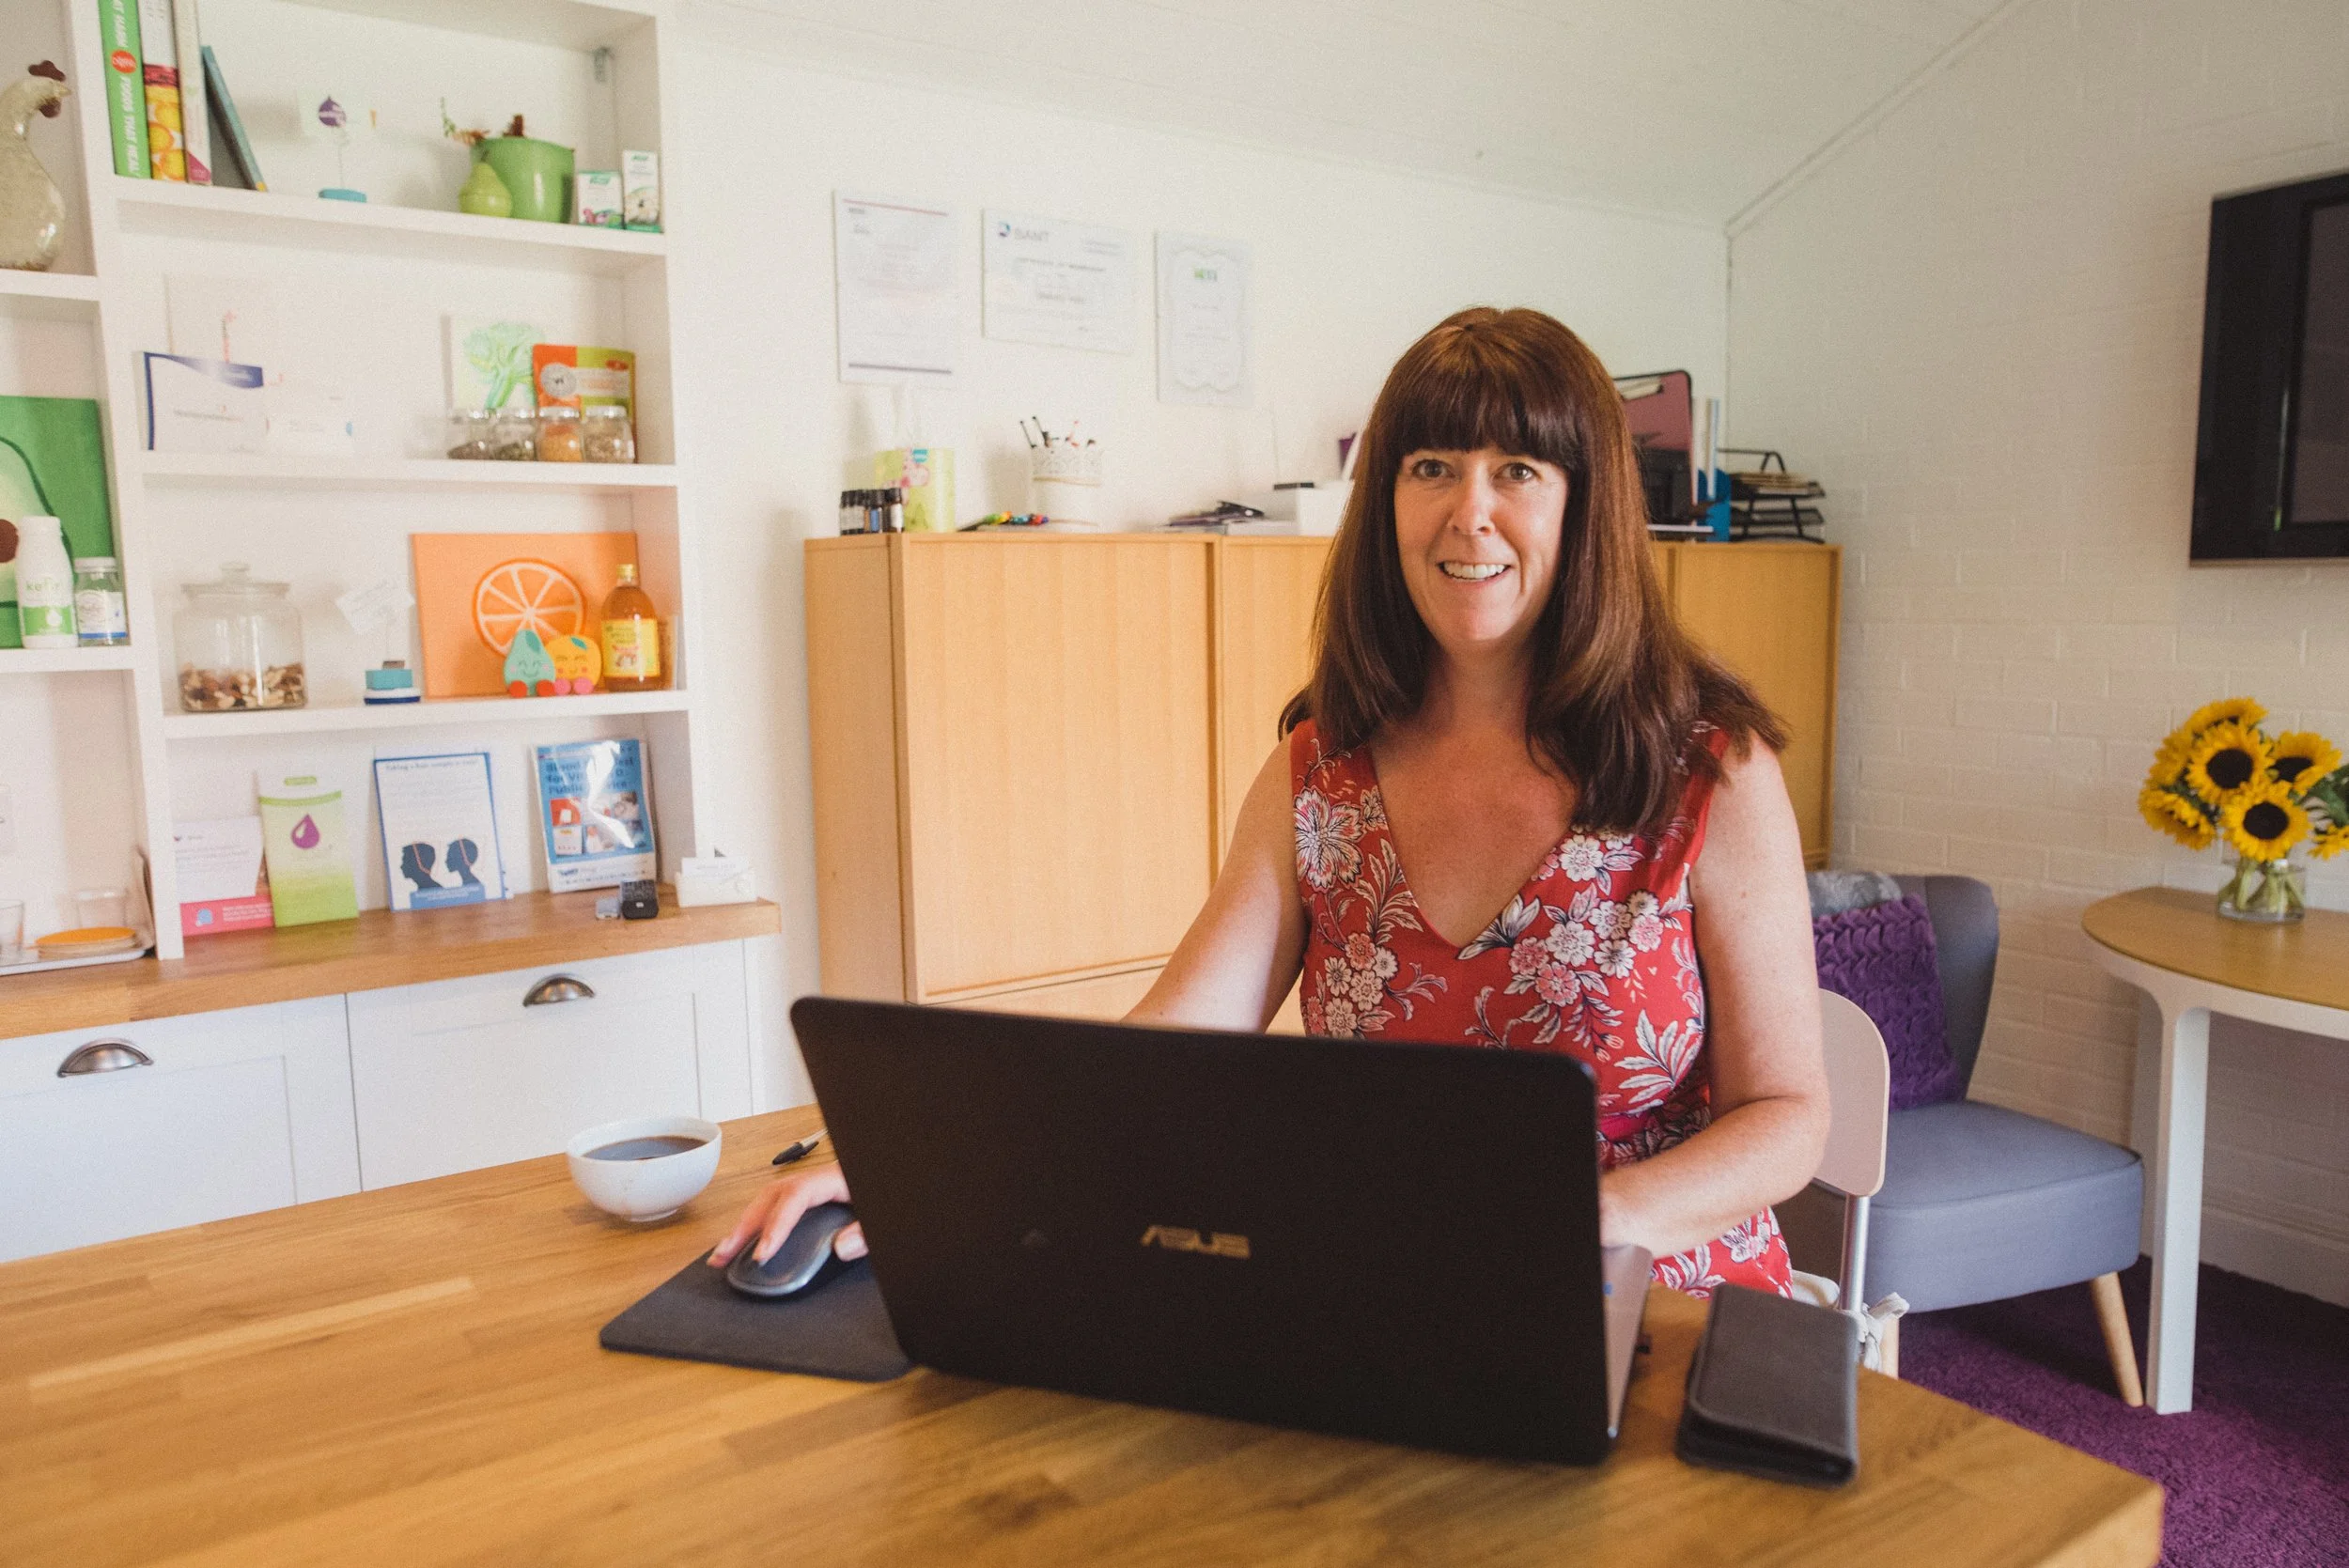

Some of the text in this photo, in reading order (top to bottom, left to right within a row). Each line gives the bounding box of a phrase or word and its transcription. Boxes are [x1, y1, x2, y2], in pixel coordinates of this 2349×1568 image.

[120, 77, 133, 112] FOODS
[124, 115, 136, 143] THAT
[1141, 1224, 1251, 1260] ASUS
